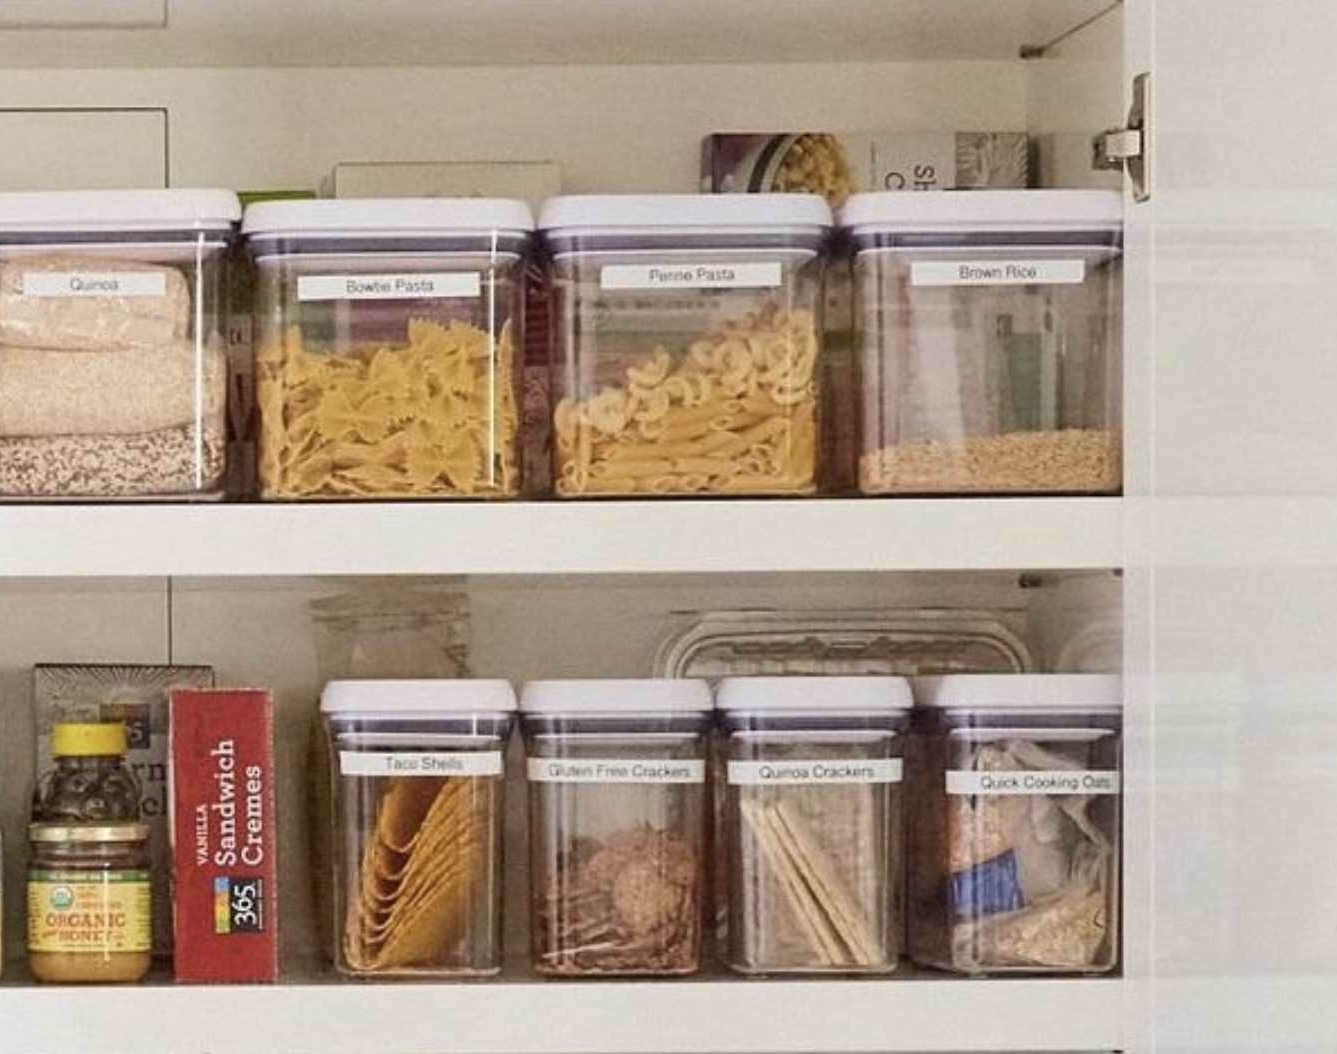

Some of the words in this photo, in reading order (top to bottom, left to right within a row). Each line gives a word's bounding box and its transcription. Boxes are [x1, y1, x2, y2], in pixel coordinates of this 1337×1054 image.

[648, 267, 693, 282] Penne
[696, 267, 736, 281] Pasta
[959, 265, 1004, 279] Brown
[1007, 265, 1037, 279] Rice
[70, 276, 119, 292] Quinoa
[345, 279, 391, 294] Bowtie
[395, 278, 435, 293] Pasta
[385, 757, 418, 771] Taco
[421, 756, 464, 771] Shells
[548, 764, 592, 779] Gluten
[595, 764, 629, 778] Free
[631, 764, 691, 779] Crackers
[759, 765, 809, 780] Quinoa
[811, 764, 875, 779] Crackers
[980, 776, 1018, 791] Quick
[1023, 775, 1079, 792] Cooking
[210, 738, 237, 867] Sandwich
[240, 765, 263, 866] Cremes
[195, 803, 209, 867] VANILLA
[45, 911, 126, 928] ORGANIC
